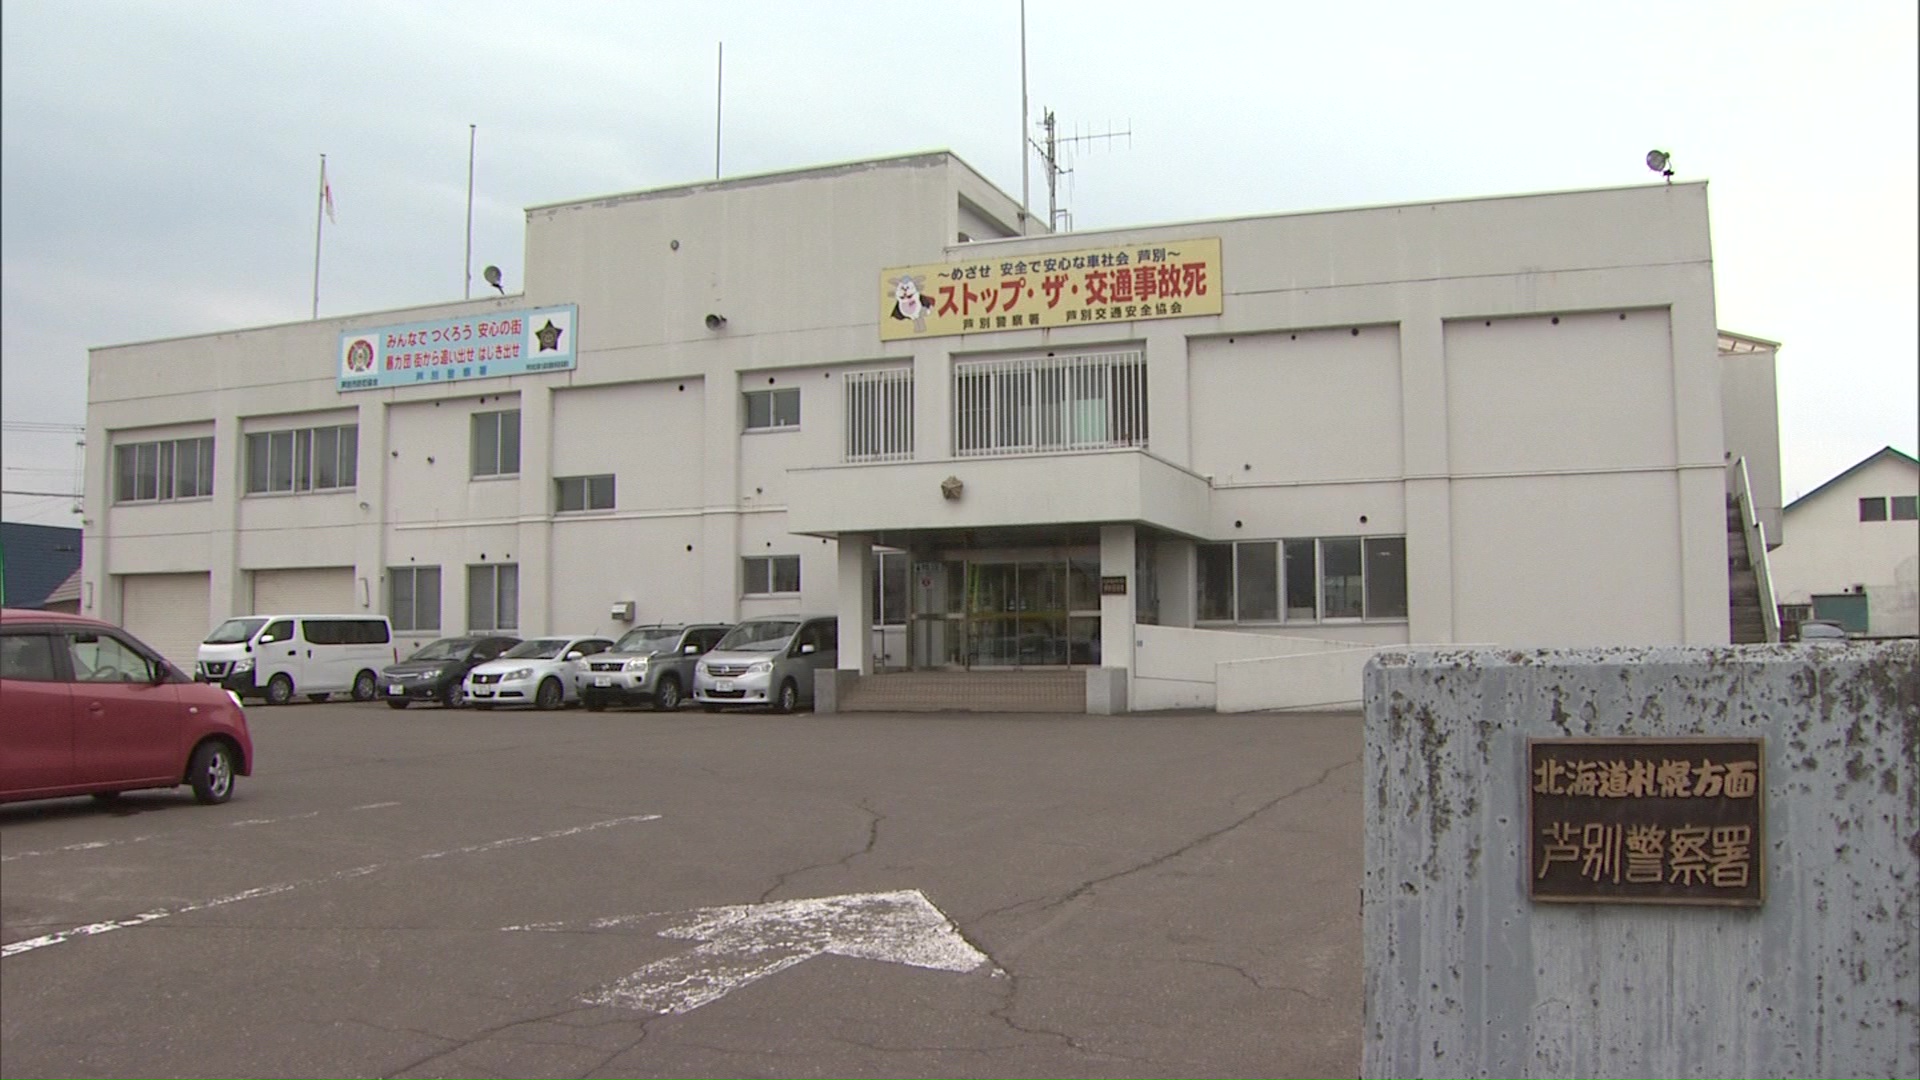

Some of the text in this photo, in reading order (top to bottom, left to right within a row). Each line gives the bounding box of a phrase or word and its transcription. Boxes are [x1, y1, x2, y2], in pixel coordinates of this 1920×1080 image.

[1000, 252, 1129, 277] 安全で安心な車社会
[938, 261, 1208, 317] ストップ・ザ・交通事故死
[963, 301, 1183, 330] 芦別警察署 芦別交通安全協会
[386, 319, 522, 348] みんなで つくろう 安心の街
[386, 343, 521, 371] 暴力団 街から追い出せ はじき出せ
[1534, 760, 1757, 798] 北海道札幌方面
[1538, 821, 1752, 888] 芦別警察署
